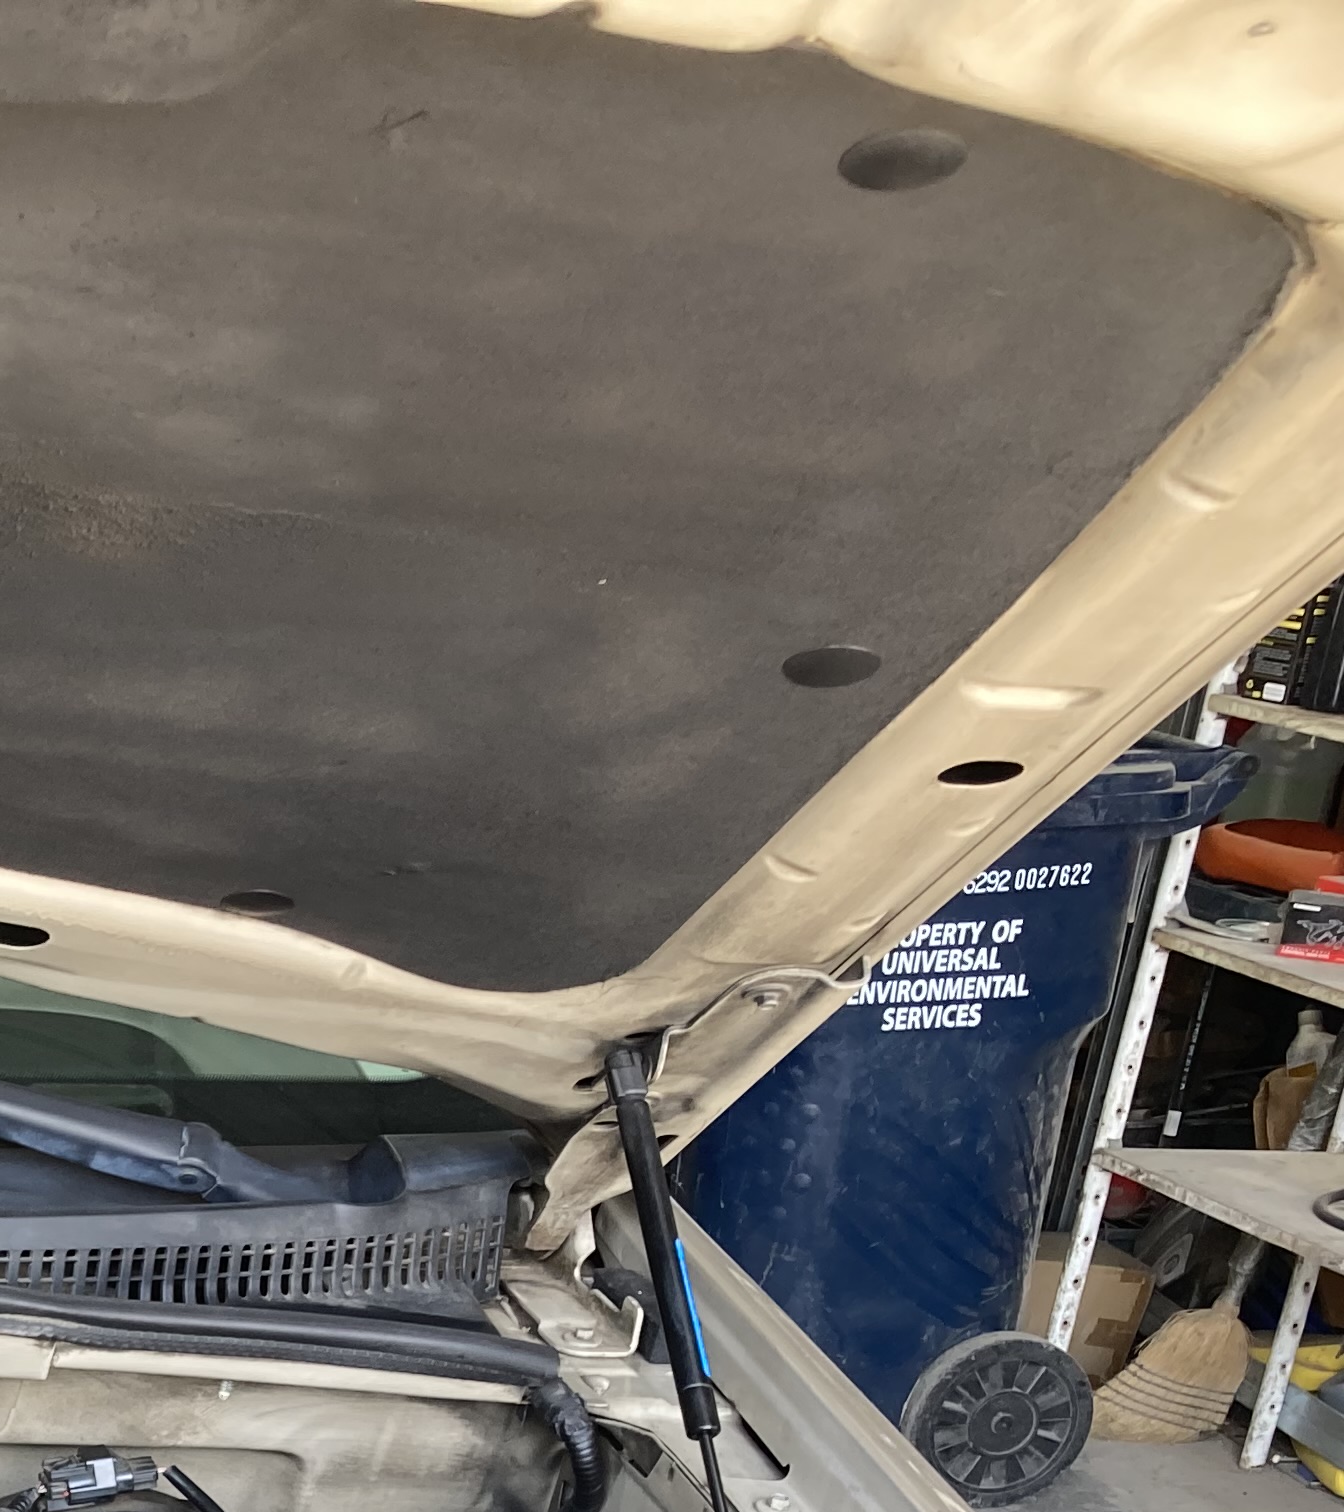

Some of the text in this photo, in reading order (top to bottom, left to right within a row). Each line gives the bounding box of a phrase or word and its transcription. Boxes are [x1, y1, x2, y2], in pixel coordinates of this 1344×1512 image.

[1015, 863, 1092, 890] 0027622
[900, 918, 1024, 947] OPERTY OF
[882, 947, 1001, 975] UNIVERSAL
[881, 1004, 982, 1031] SERVICES
